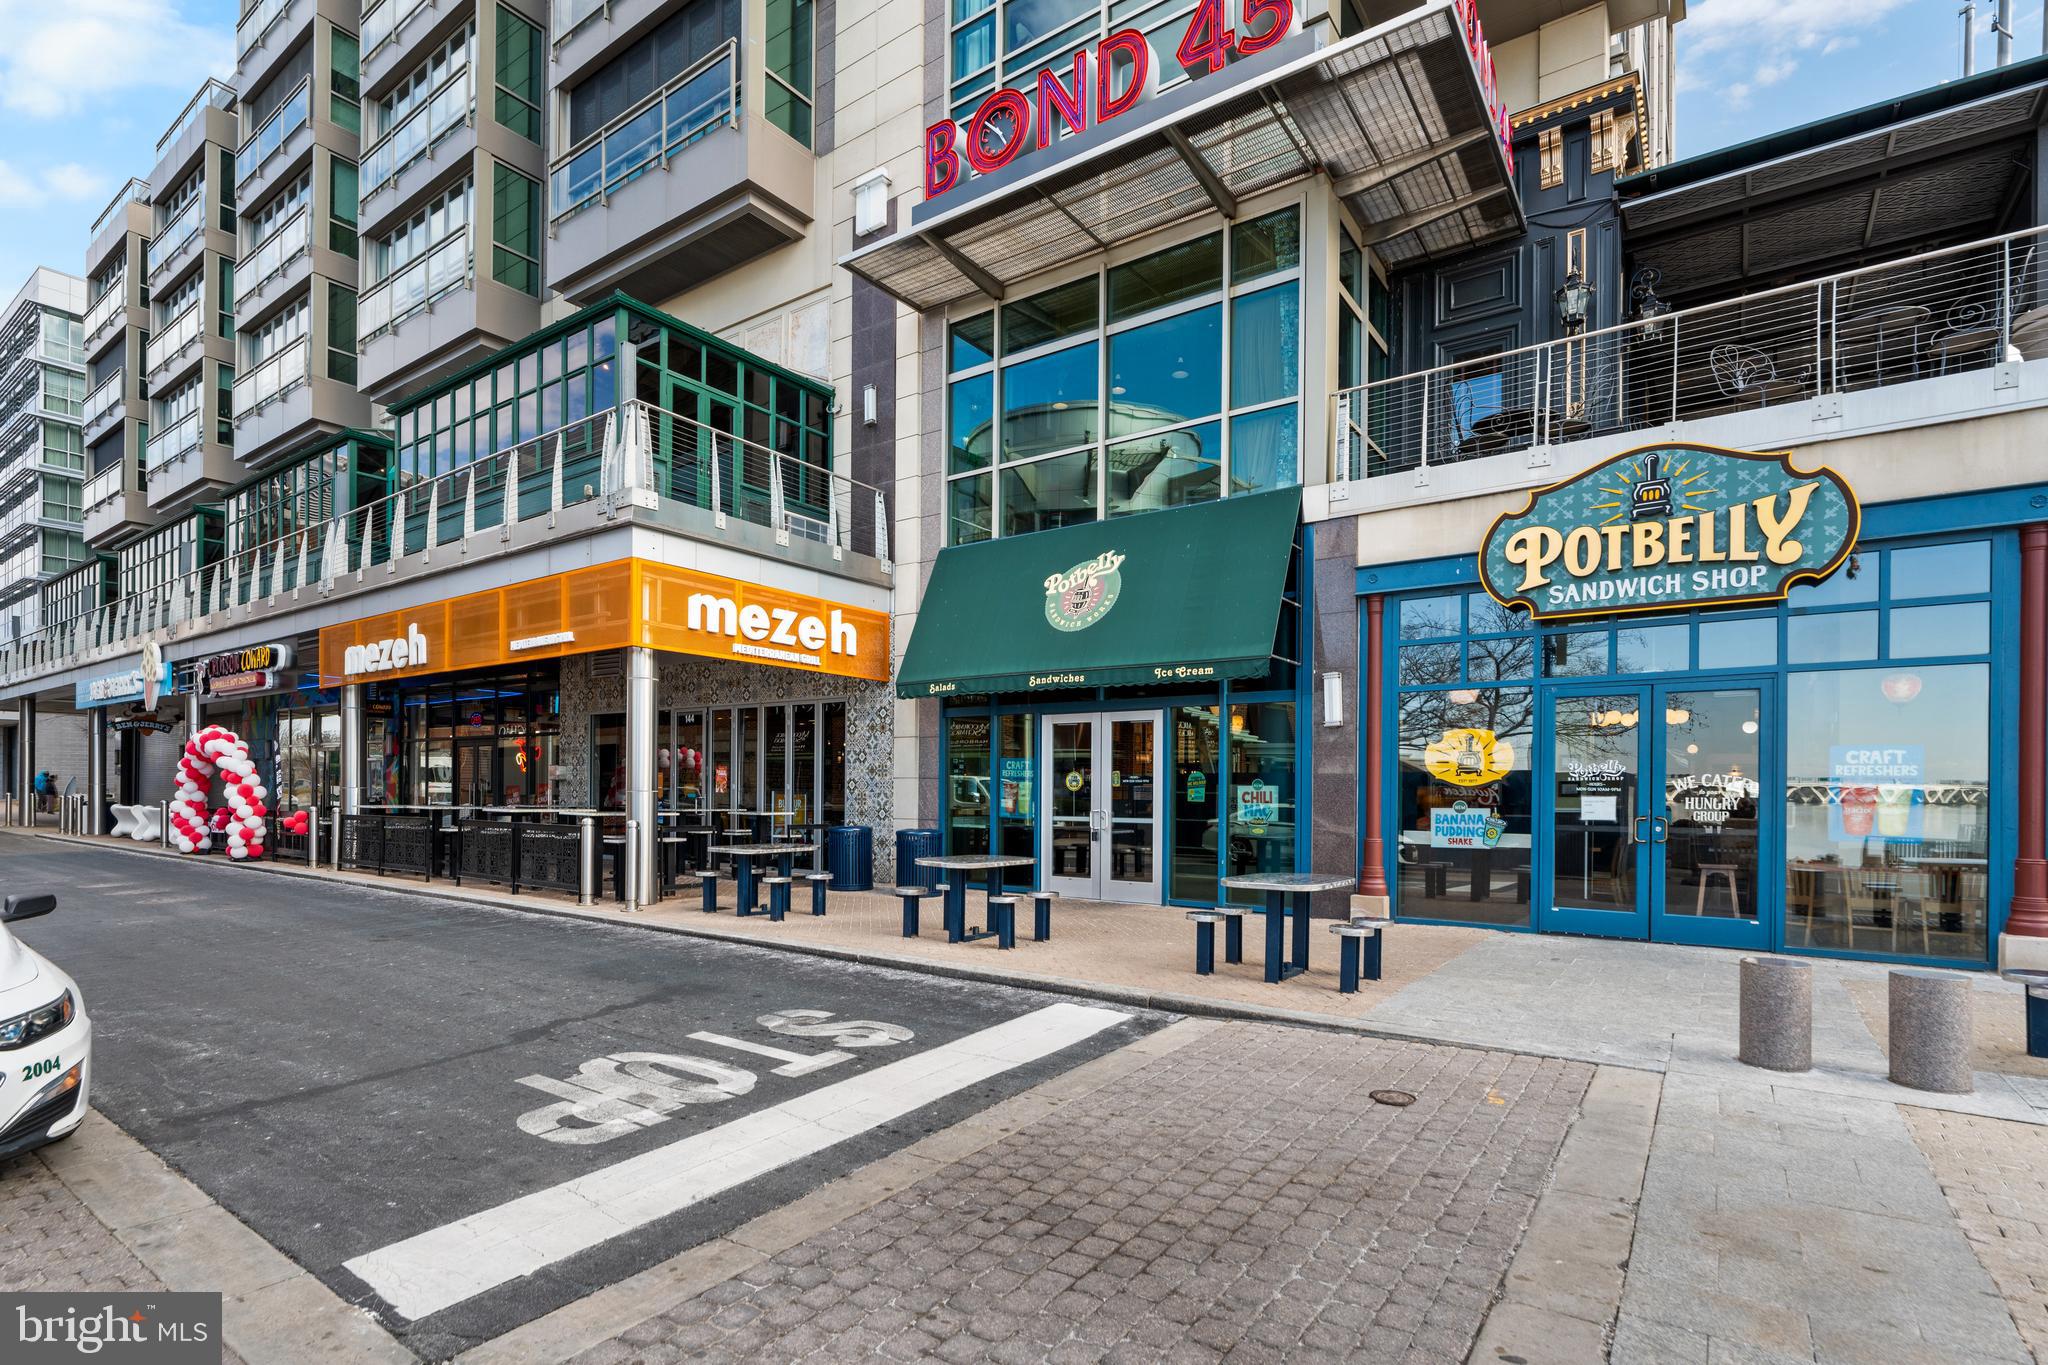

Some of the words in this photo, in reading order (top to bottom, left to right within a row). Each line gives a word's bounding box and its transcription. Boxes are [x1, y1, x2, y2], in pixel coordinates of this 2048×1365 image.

[926, 28, 1149, 200] BOND
[1177, 0, 1294, 74] 45
[1504, 481, 1821, 593] POTBELLY
[1044, 550, 1126, 596] Potbelly
[1548, 573, 1681, 605] SANDWICH
[1692, 565, 1767, 592] SHOP
[687, 592, 858, 656] mezeh
[344, 622, 428, 675] mezeh
[241, 646, 271, 672] COWARD
[1154, 667, 1173, 679] Ice
[1176, 665, 1214, 678] Cream
[1029, 674, 1085, 687] Sandwiches
[929, 683, 956, 694] Salads
[1845, 749, 1907, 764] CRAFT
[1567, 759, 1627, 781] Potbelly
[1835, 765, 1919, 776] REFRESHERS
[1672, 775, 1698, 791] WE
[1241, 791, 1273, 804] CHILI
[1685, 797, 1741, 810] HUNGRY
[1435, 814, 1485, 825] BANANA
[1693, 811, 1730, 822] GROUP
[1435, 826, 1485, 837] PUDDING
[22, 1055, 61, 1082] 2004
